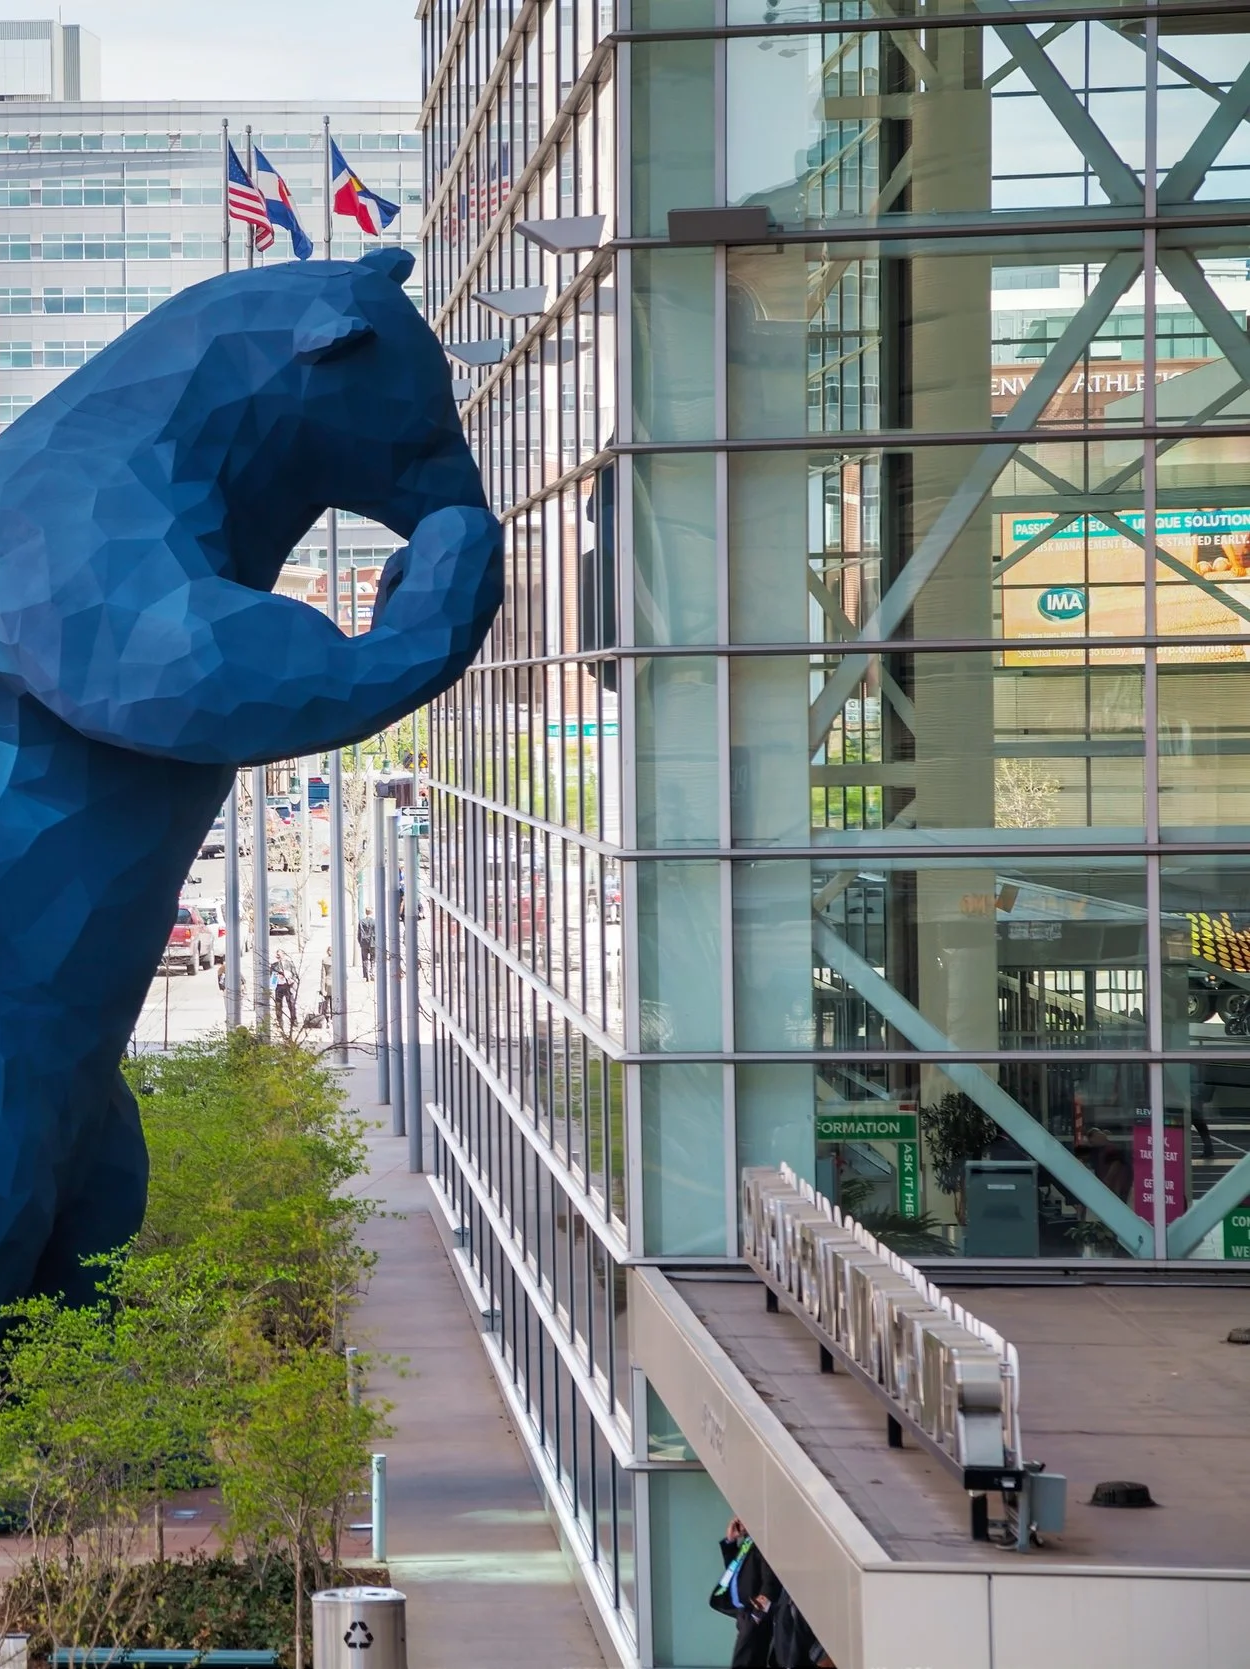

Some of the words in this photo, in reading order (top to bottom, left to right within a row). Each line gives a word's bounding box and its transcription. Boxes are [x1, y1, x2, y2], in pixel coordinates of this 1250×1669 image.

[1214, 533, 1250, 545] EARLY.
[1047, 593, 1084, 611] IMA
[904, 1143, 914, 1173] ASK
[905, 1176, 914, 1190] IT
